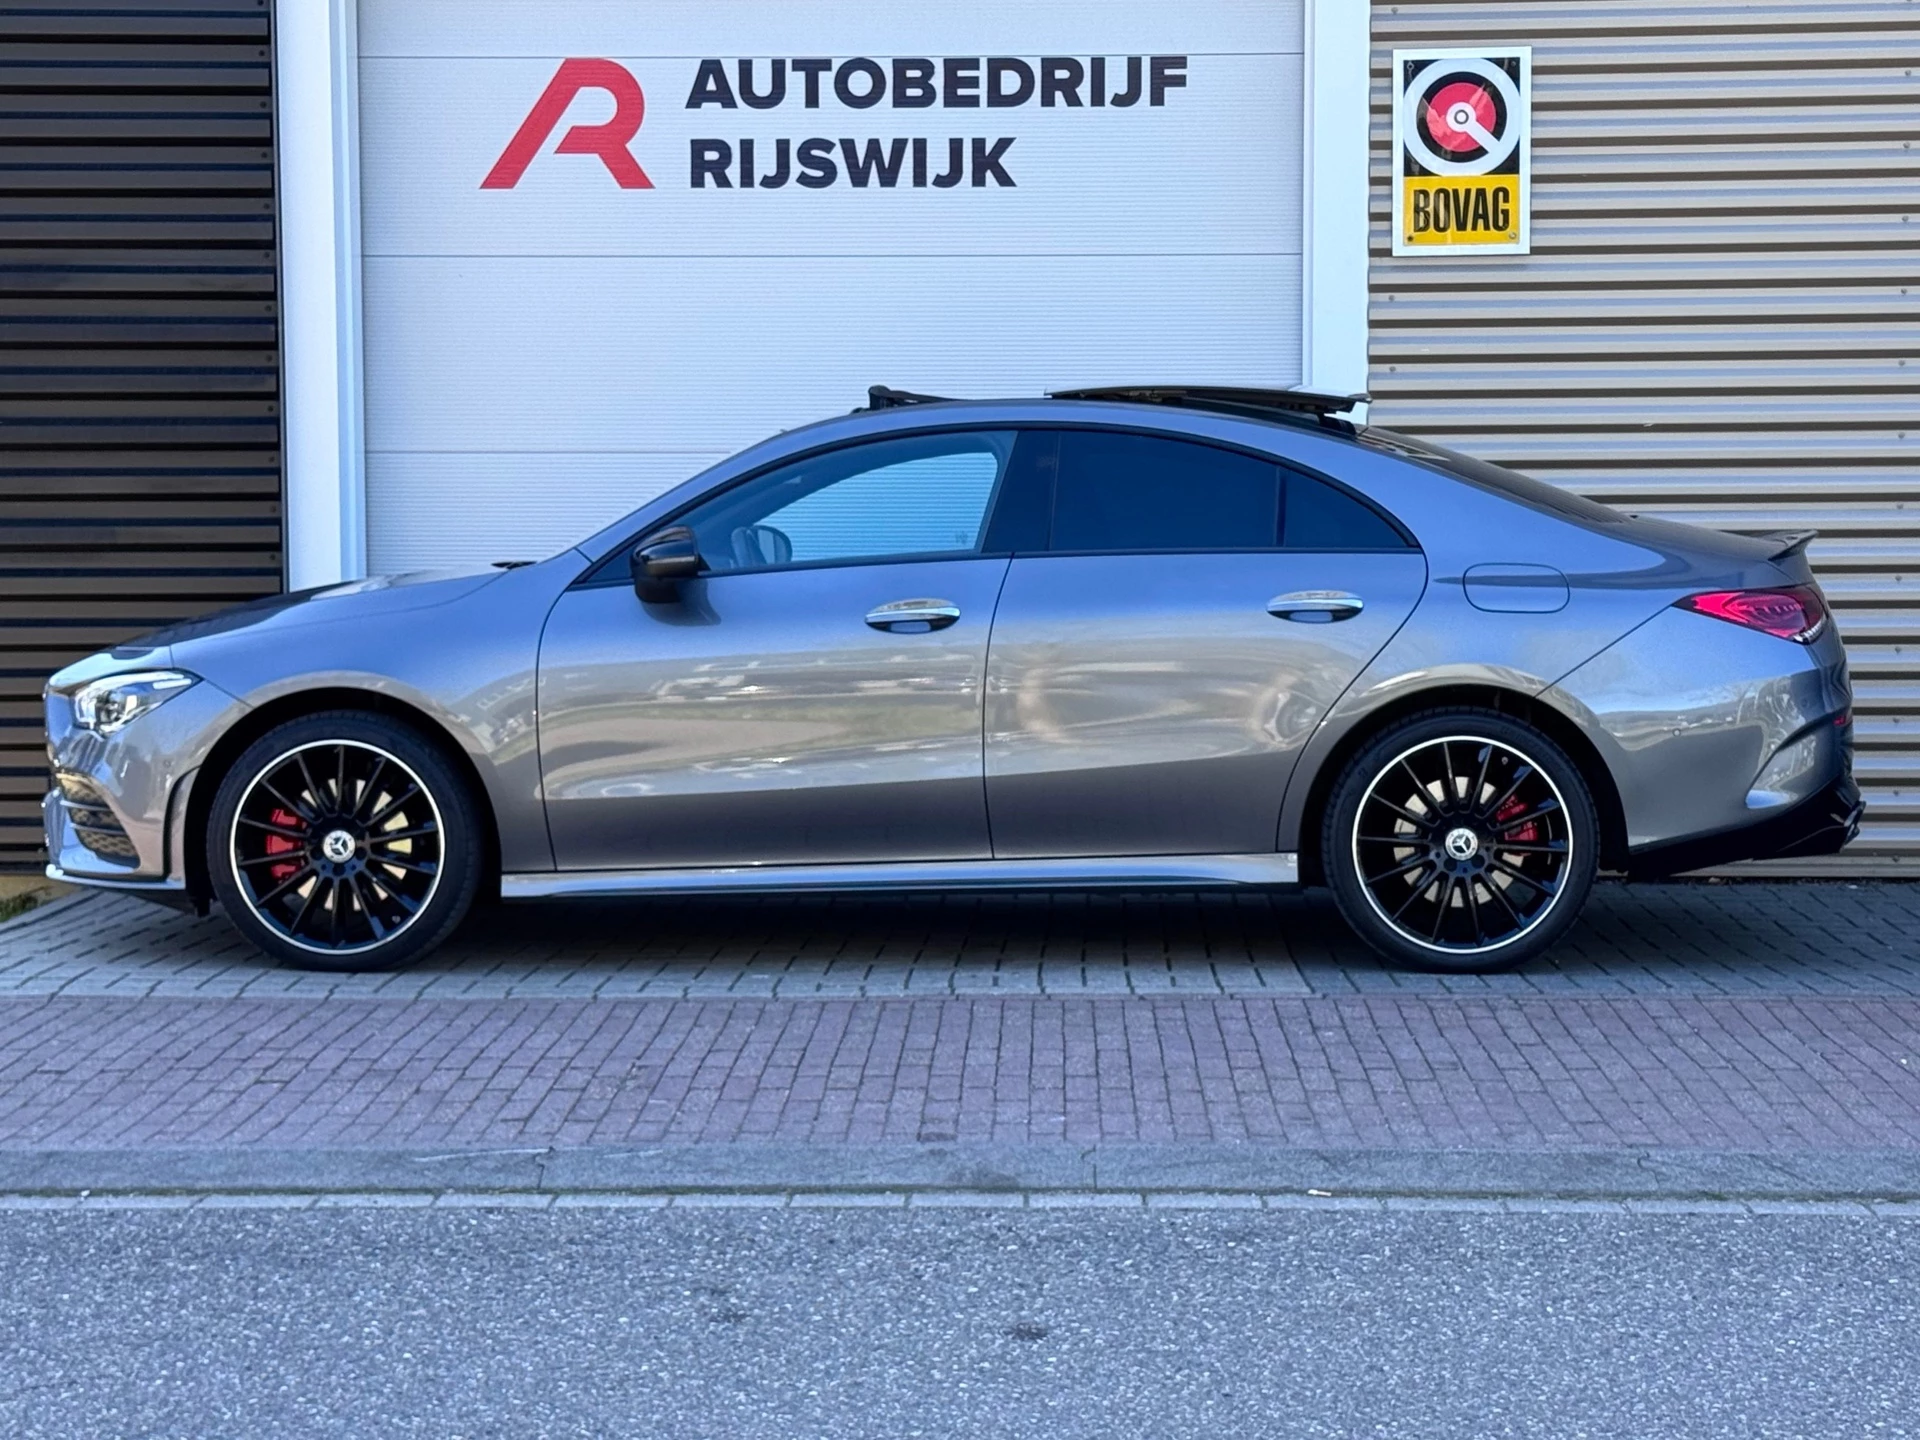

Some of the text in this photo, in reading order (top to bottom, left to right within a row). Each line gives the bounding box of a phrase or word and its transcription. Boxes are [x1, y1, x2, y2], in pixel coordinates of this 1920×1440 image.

[686, 56, 1187, 109] AUTOBEDRIJF
[690, 137, 1017, 189] RIJSWIJK
[1413, 187, 1510, 233] BOVAG
